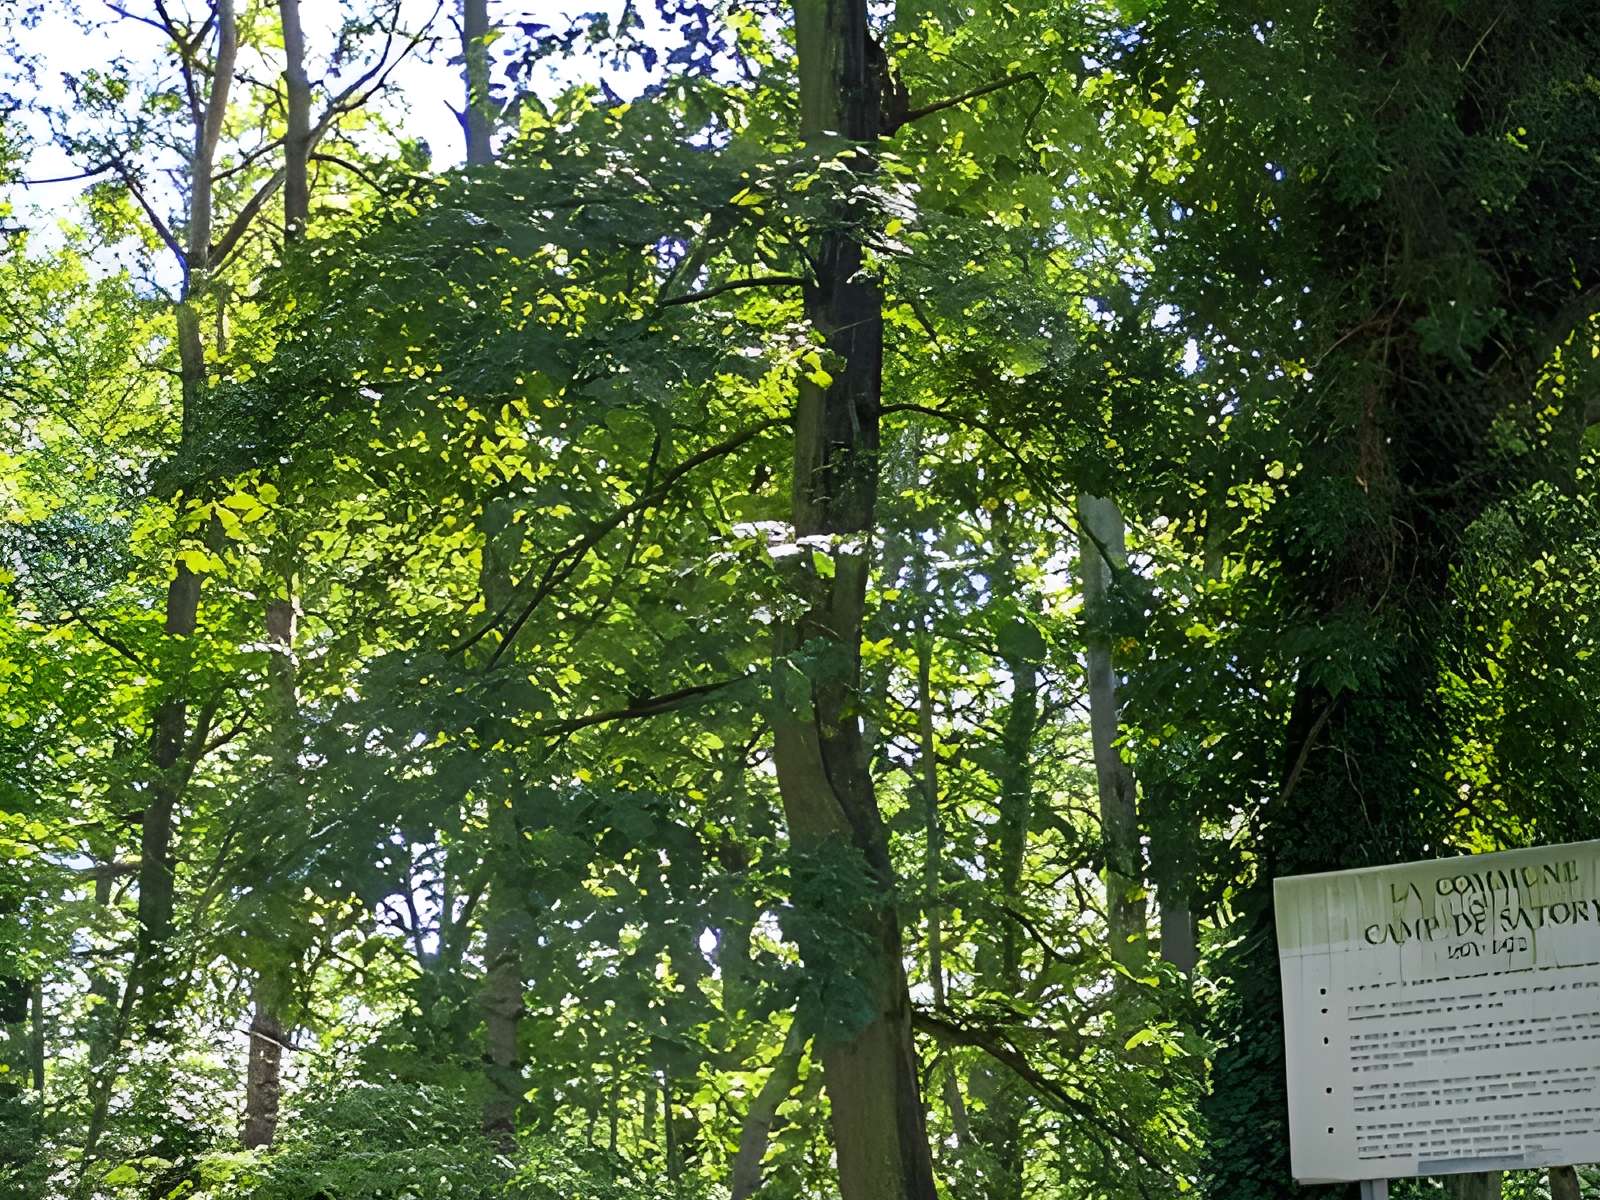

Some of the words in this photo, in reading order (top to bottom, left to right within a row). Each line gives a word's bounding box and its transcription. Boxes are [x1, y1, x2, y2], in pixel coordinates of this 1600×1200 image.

[1436, 859, 1579, 898] COMMUNE
[1364, 915, 1444, 945] CAMP
[1452, 908, 1488, 938] DE
